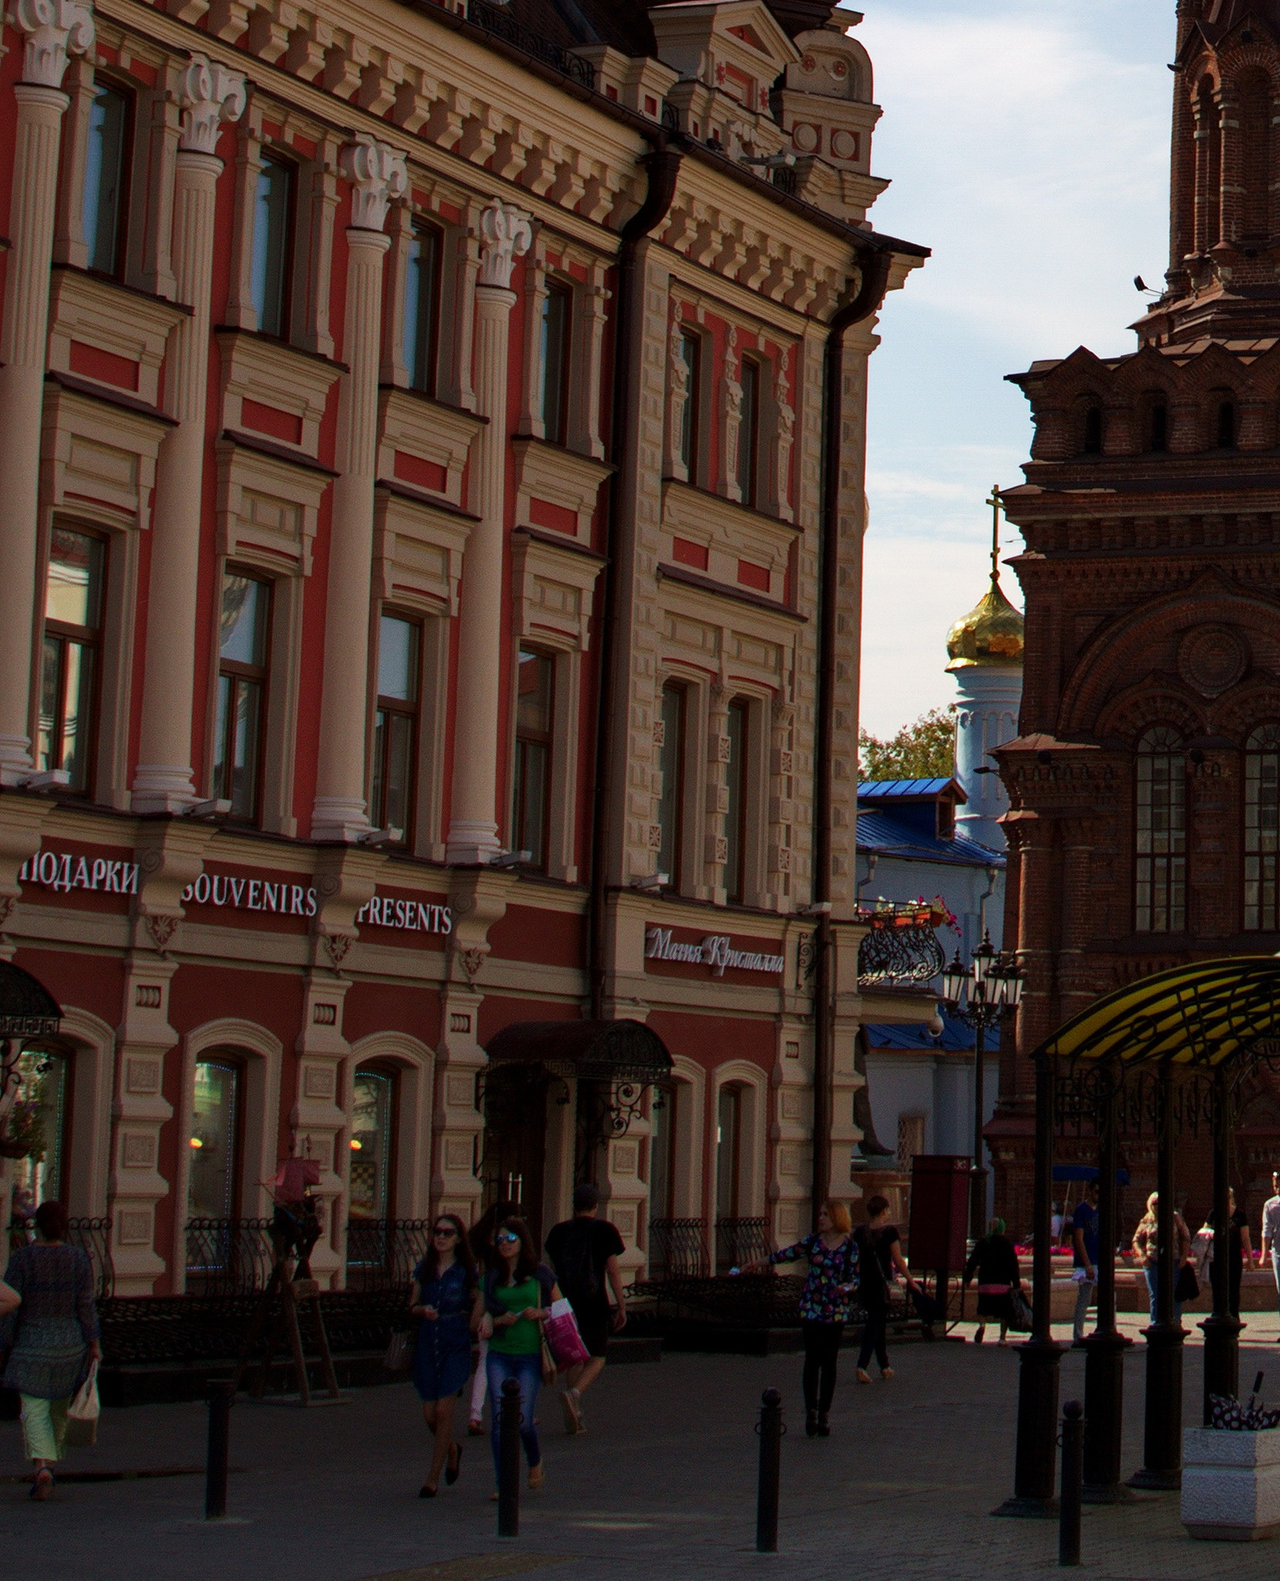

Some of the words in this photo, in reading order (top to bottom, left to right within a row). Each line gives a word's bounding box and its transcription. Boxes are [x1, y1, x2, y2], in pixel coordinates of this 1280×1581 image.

[19, 850, 140, 895] ПОДАРКИ
[356, 895, 452, 935] PRESENTS
[649, 927, 702, 964] Магия
[708, 935, 784, 977] Кристалла
